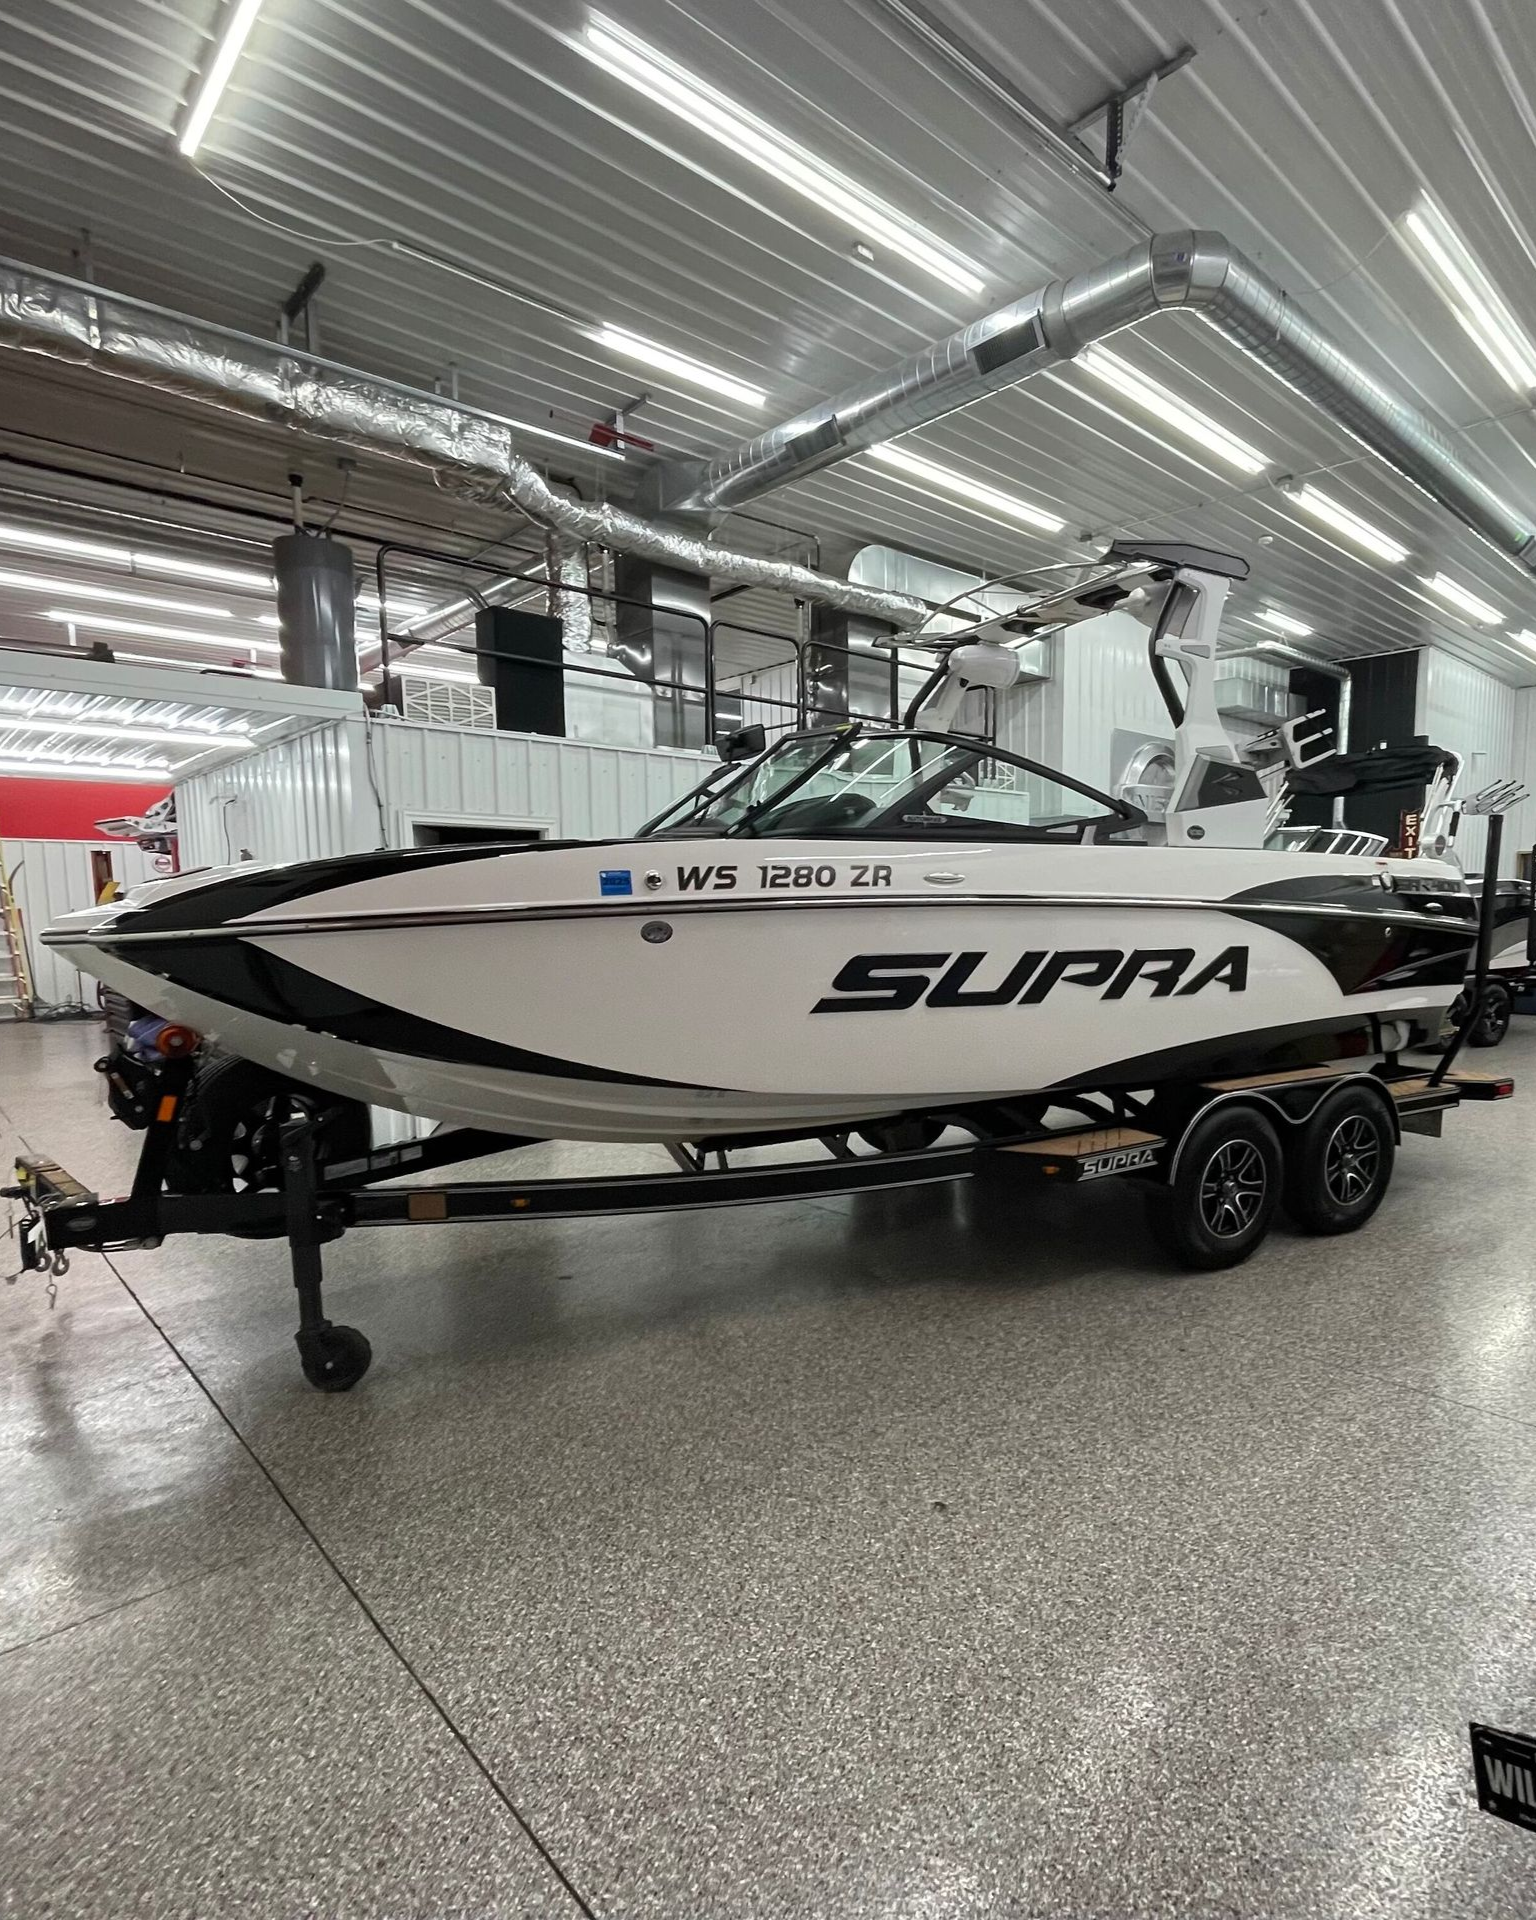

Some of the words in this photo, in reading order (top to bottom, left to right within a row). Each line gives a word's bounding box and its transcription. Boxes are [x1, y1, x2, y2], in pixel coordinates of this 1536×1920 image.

[1404, 814, 1417, 859] EXIT
[677, 865, 738, 891] WS
[756, 865, 836, 889] 1280
[850, 865, 892, 888] ZR
[809, 945, 1249, 1014] SUPRA
[1083, 1149, 1154, 1176] SUPRA
